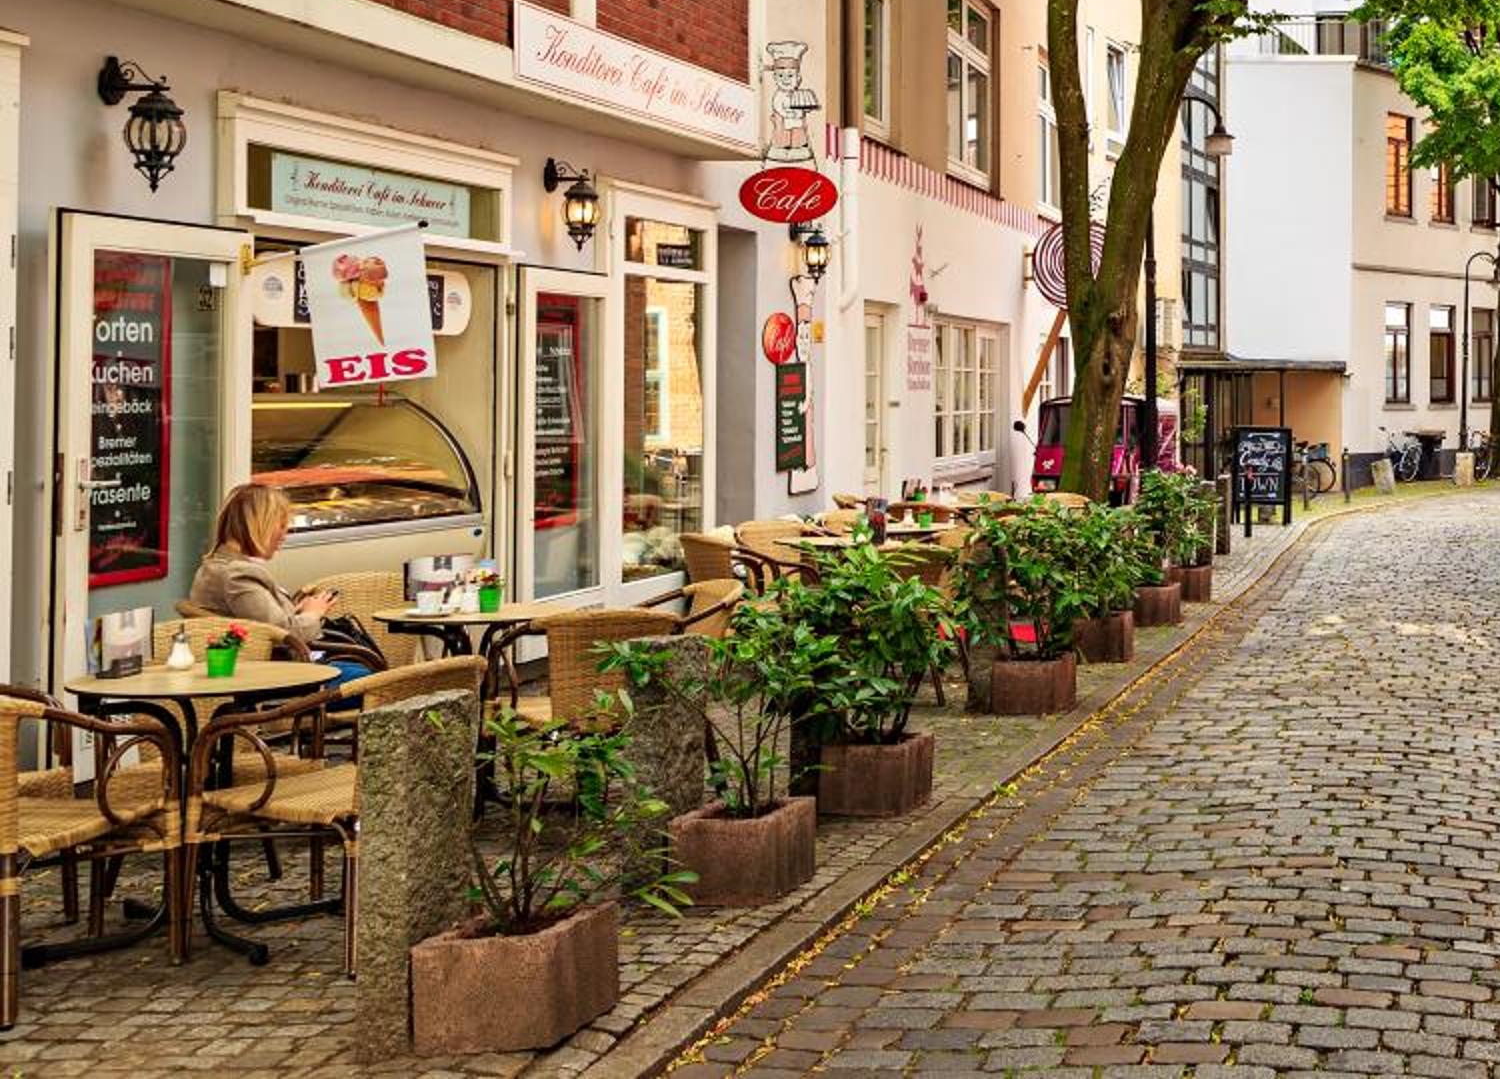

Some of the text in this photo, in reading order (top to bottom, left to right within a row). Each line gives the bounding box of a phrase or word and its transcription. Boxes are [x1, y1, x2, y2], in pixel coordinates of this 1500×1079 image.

[536, 24, 624, 87] Konditorei
[753, 178, 822, 221] Cafe
[93, 315, 153, 343] orten
[324, 348, 428, 384] EIS
[91, 451, 153, 468] pezialitäten
[91, 482, 151, 506] räsente
